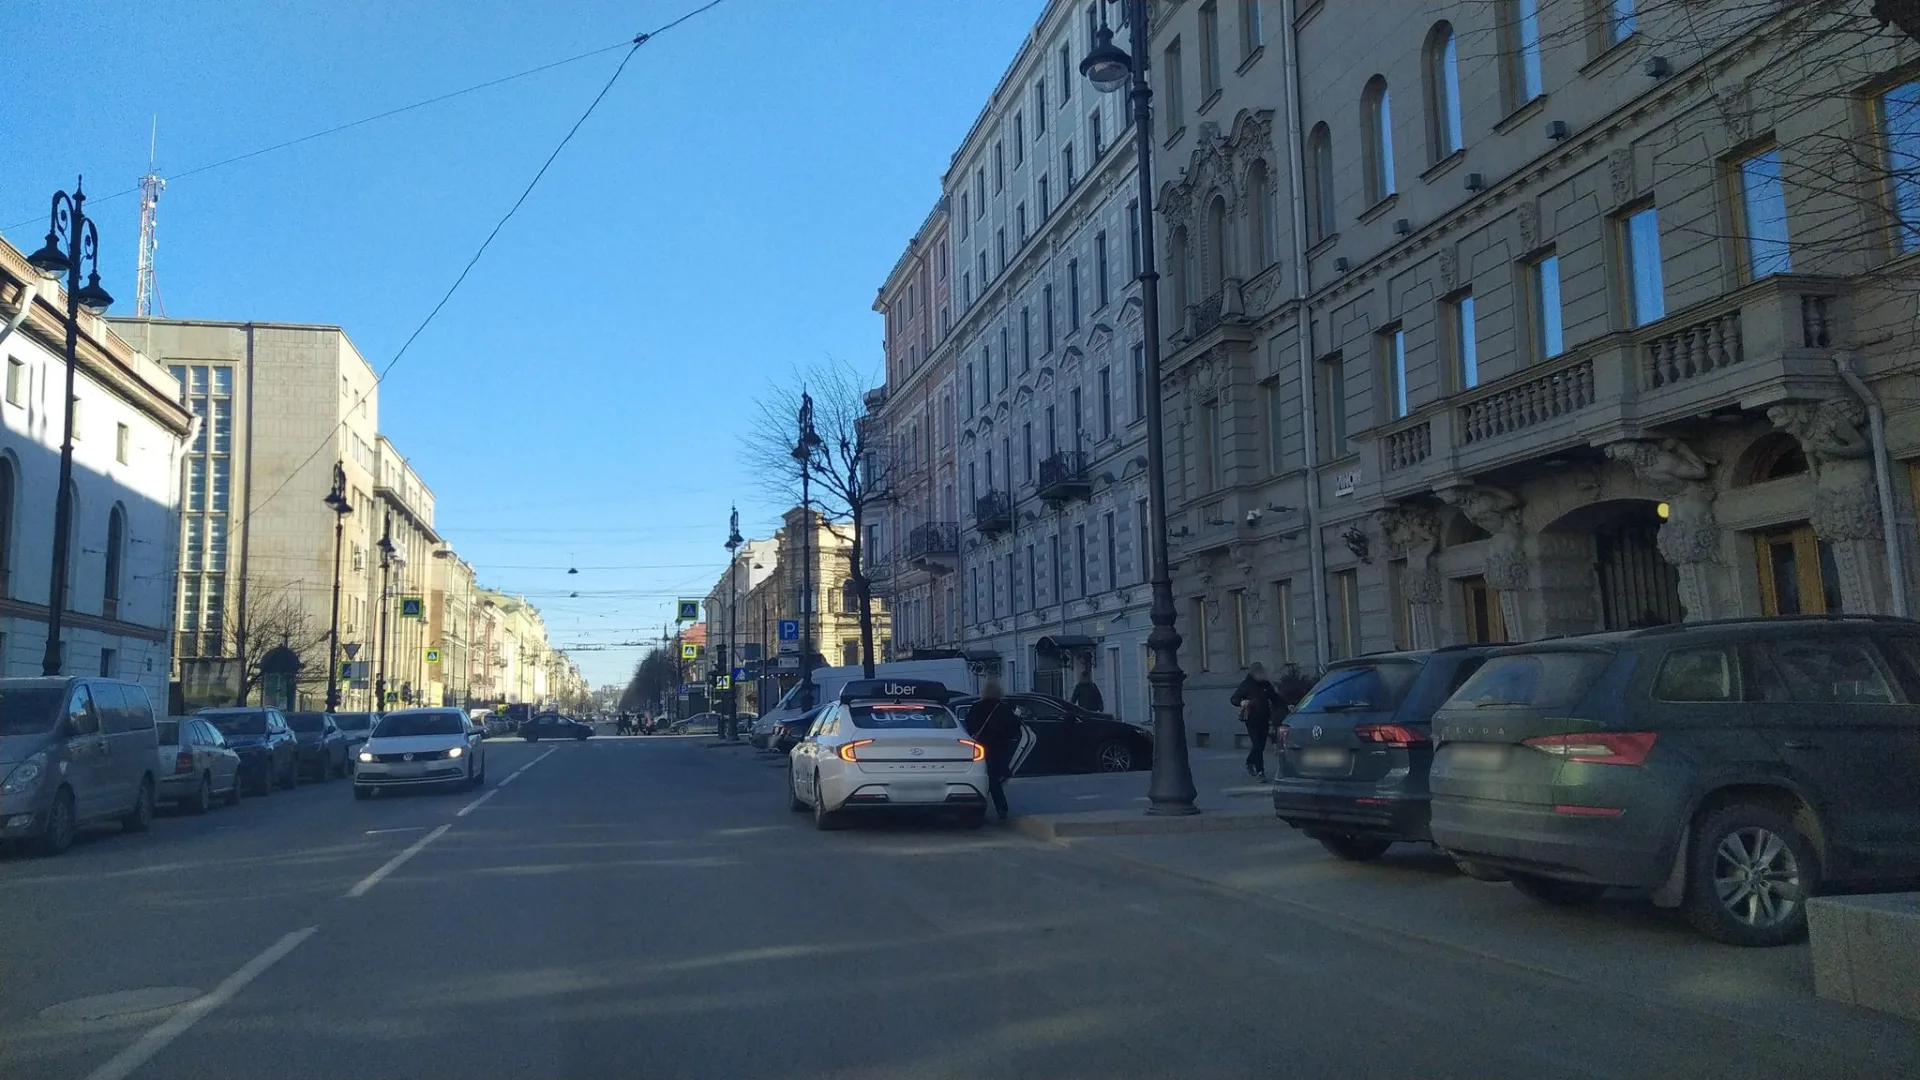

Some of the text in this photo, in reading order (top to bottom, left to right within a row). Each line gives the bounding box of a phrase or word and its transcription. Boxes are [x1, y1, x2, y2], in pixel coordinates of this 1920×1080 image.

[784, 622, 795, 638] P
[884, 682, 917, 695] Uber
[870, 712, 933, 721] Uber
